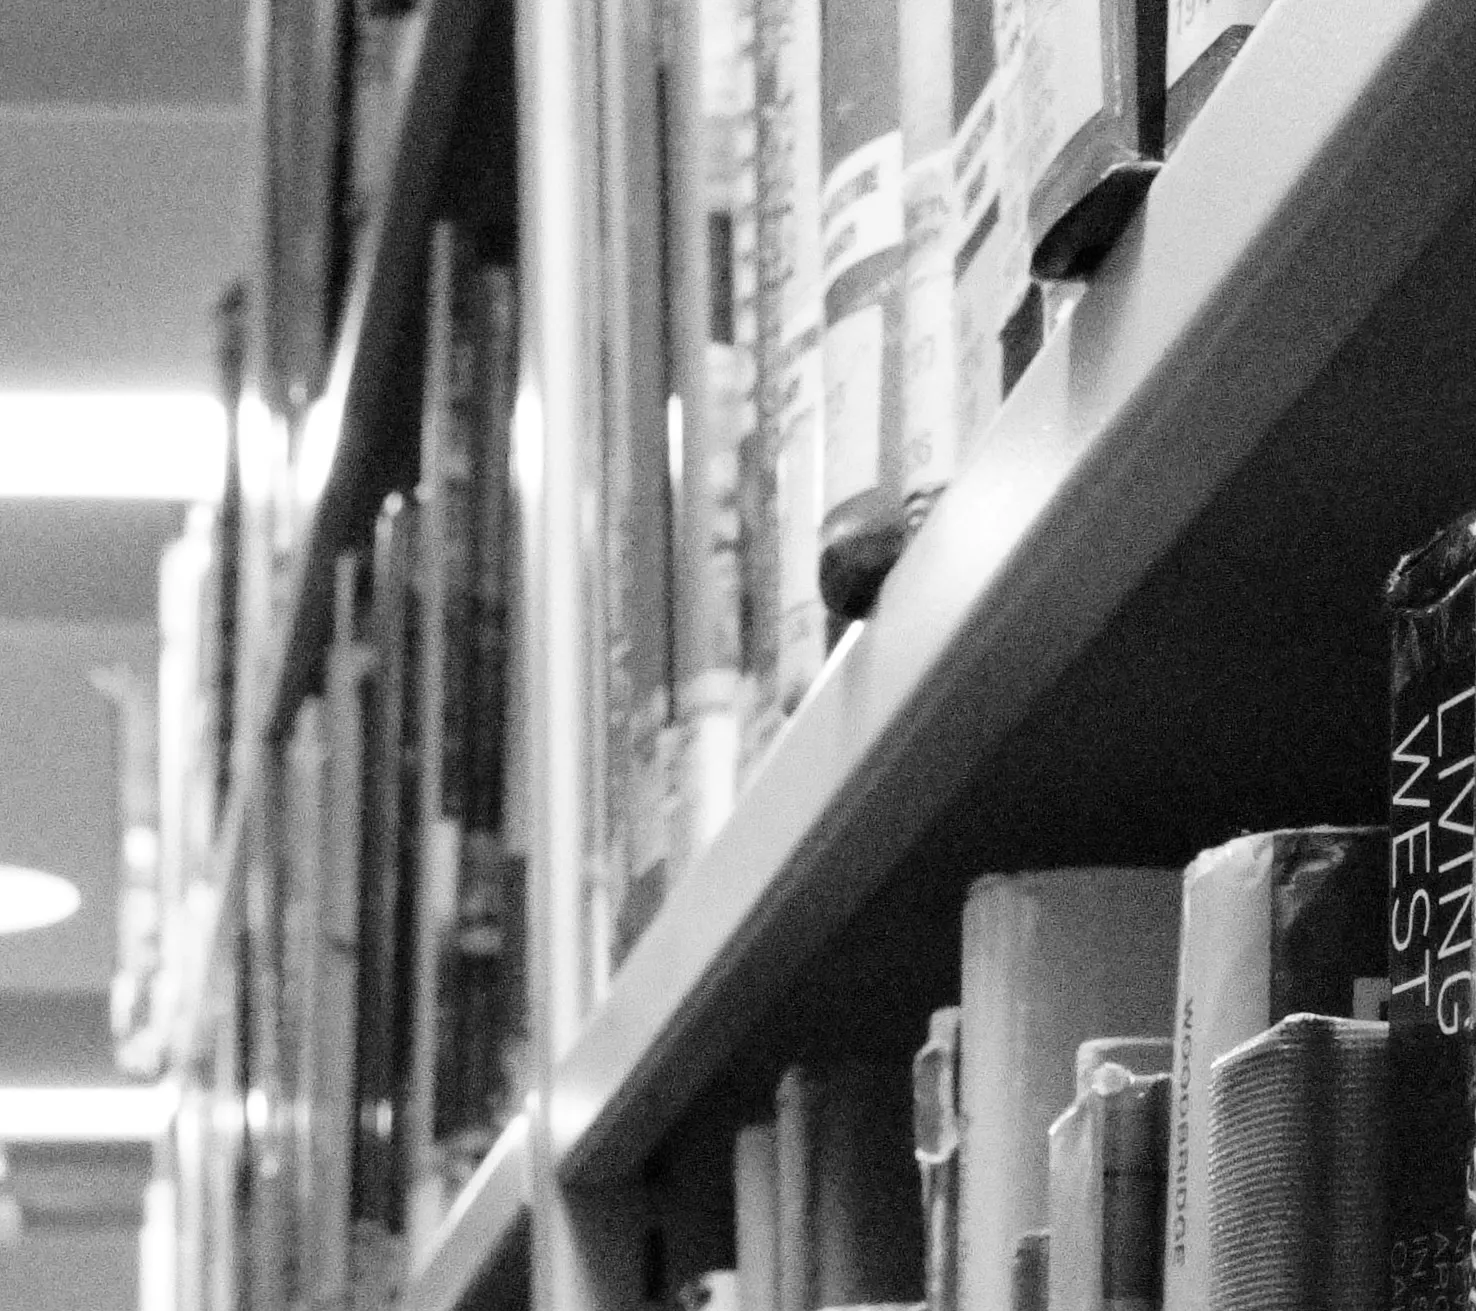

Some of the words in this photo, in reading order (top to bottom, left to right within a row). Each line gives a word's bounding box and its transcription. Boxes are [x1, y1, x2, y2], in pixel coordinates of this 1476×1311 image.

[1389, 713, 1434, 1008] WEST
[1172, 993, 1198, 1270] WOODBRIDGE
[1411, 1233, 1430, 1280] IN
